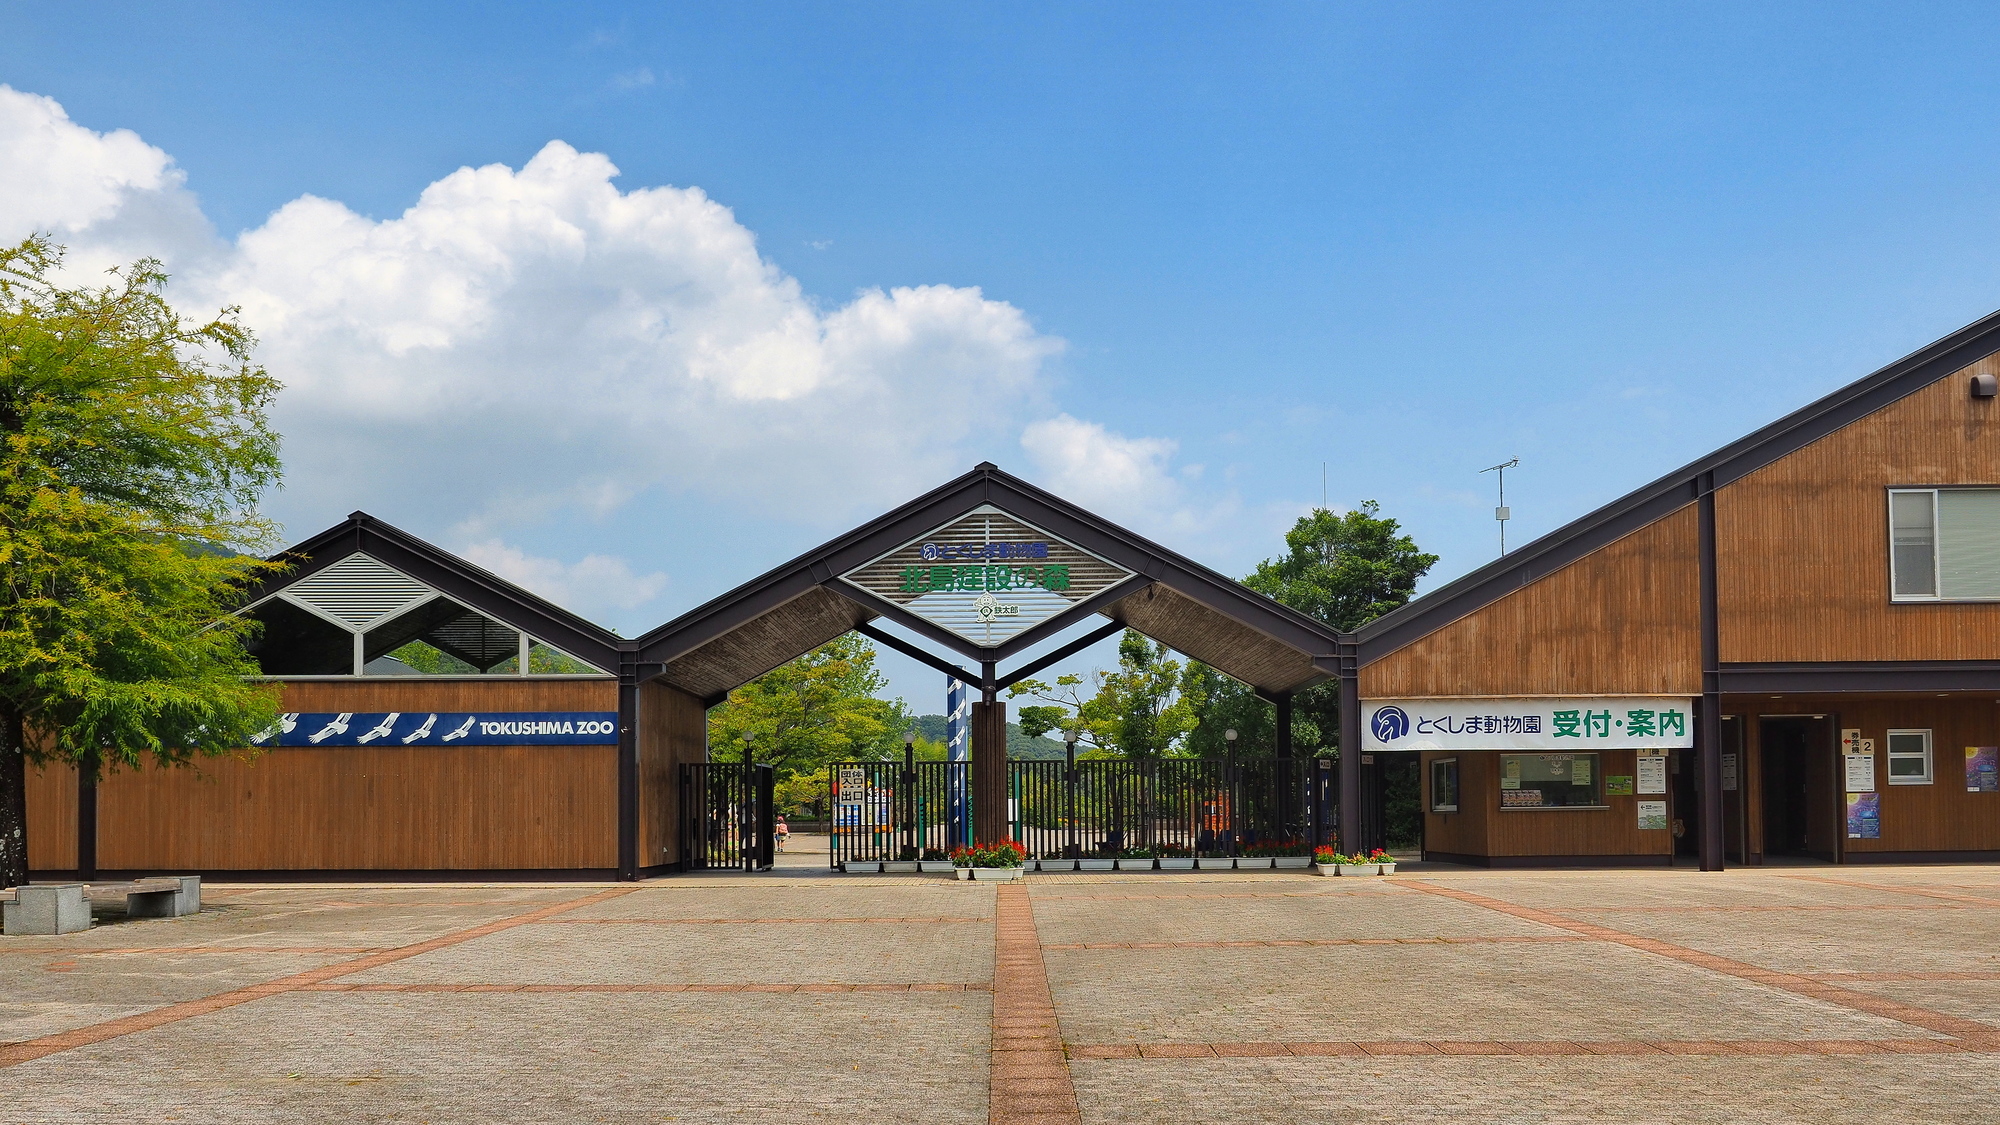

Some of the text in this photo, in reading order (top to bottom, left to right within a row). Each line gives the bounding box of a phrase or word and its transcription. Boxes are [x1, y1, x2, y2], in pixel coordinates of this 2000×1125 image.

[942, 542, 1048, 558] とくしま動物園
[899, 565, 1071, 592] 北島建設の森
[480, 721, 614, 735] TOKUSHIMA ZOO
[1416, 714, 1542, 734] とくしま動物園
[1552, 709, 1685, 738] 受付・案内
[1851, 732, 1860, 753] 券売機
[1864, 742, 1871, 751] 2
[842, 791, 862, 801] 出口
